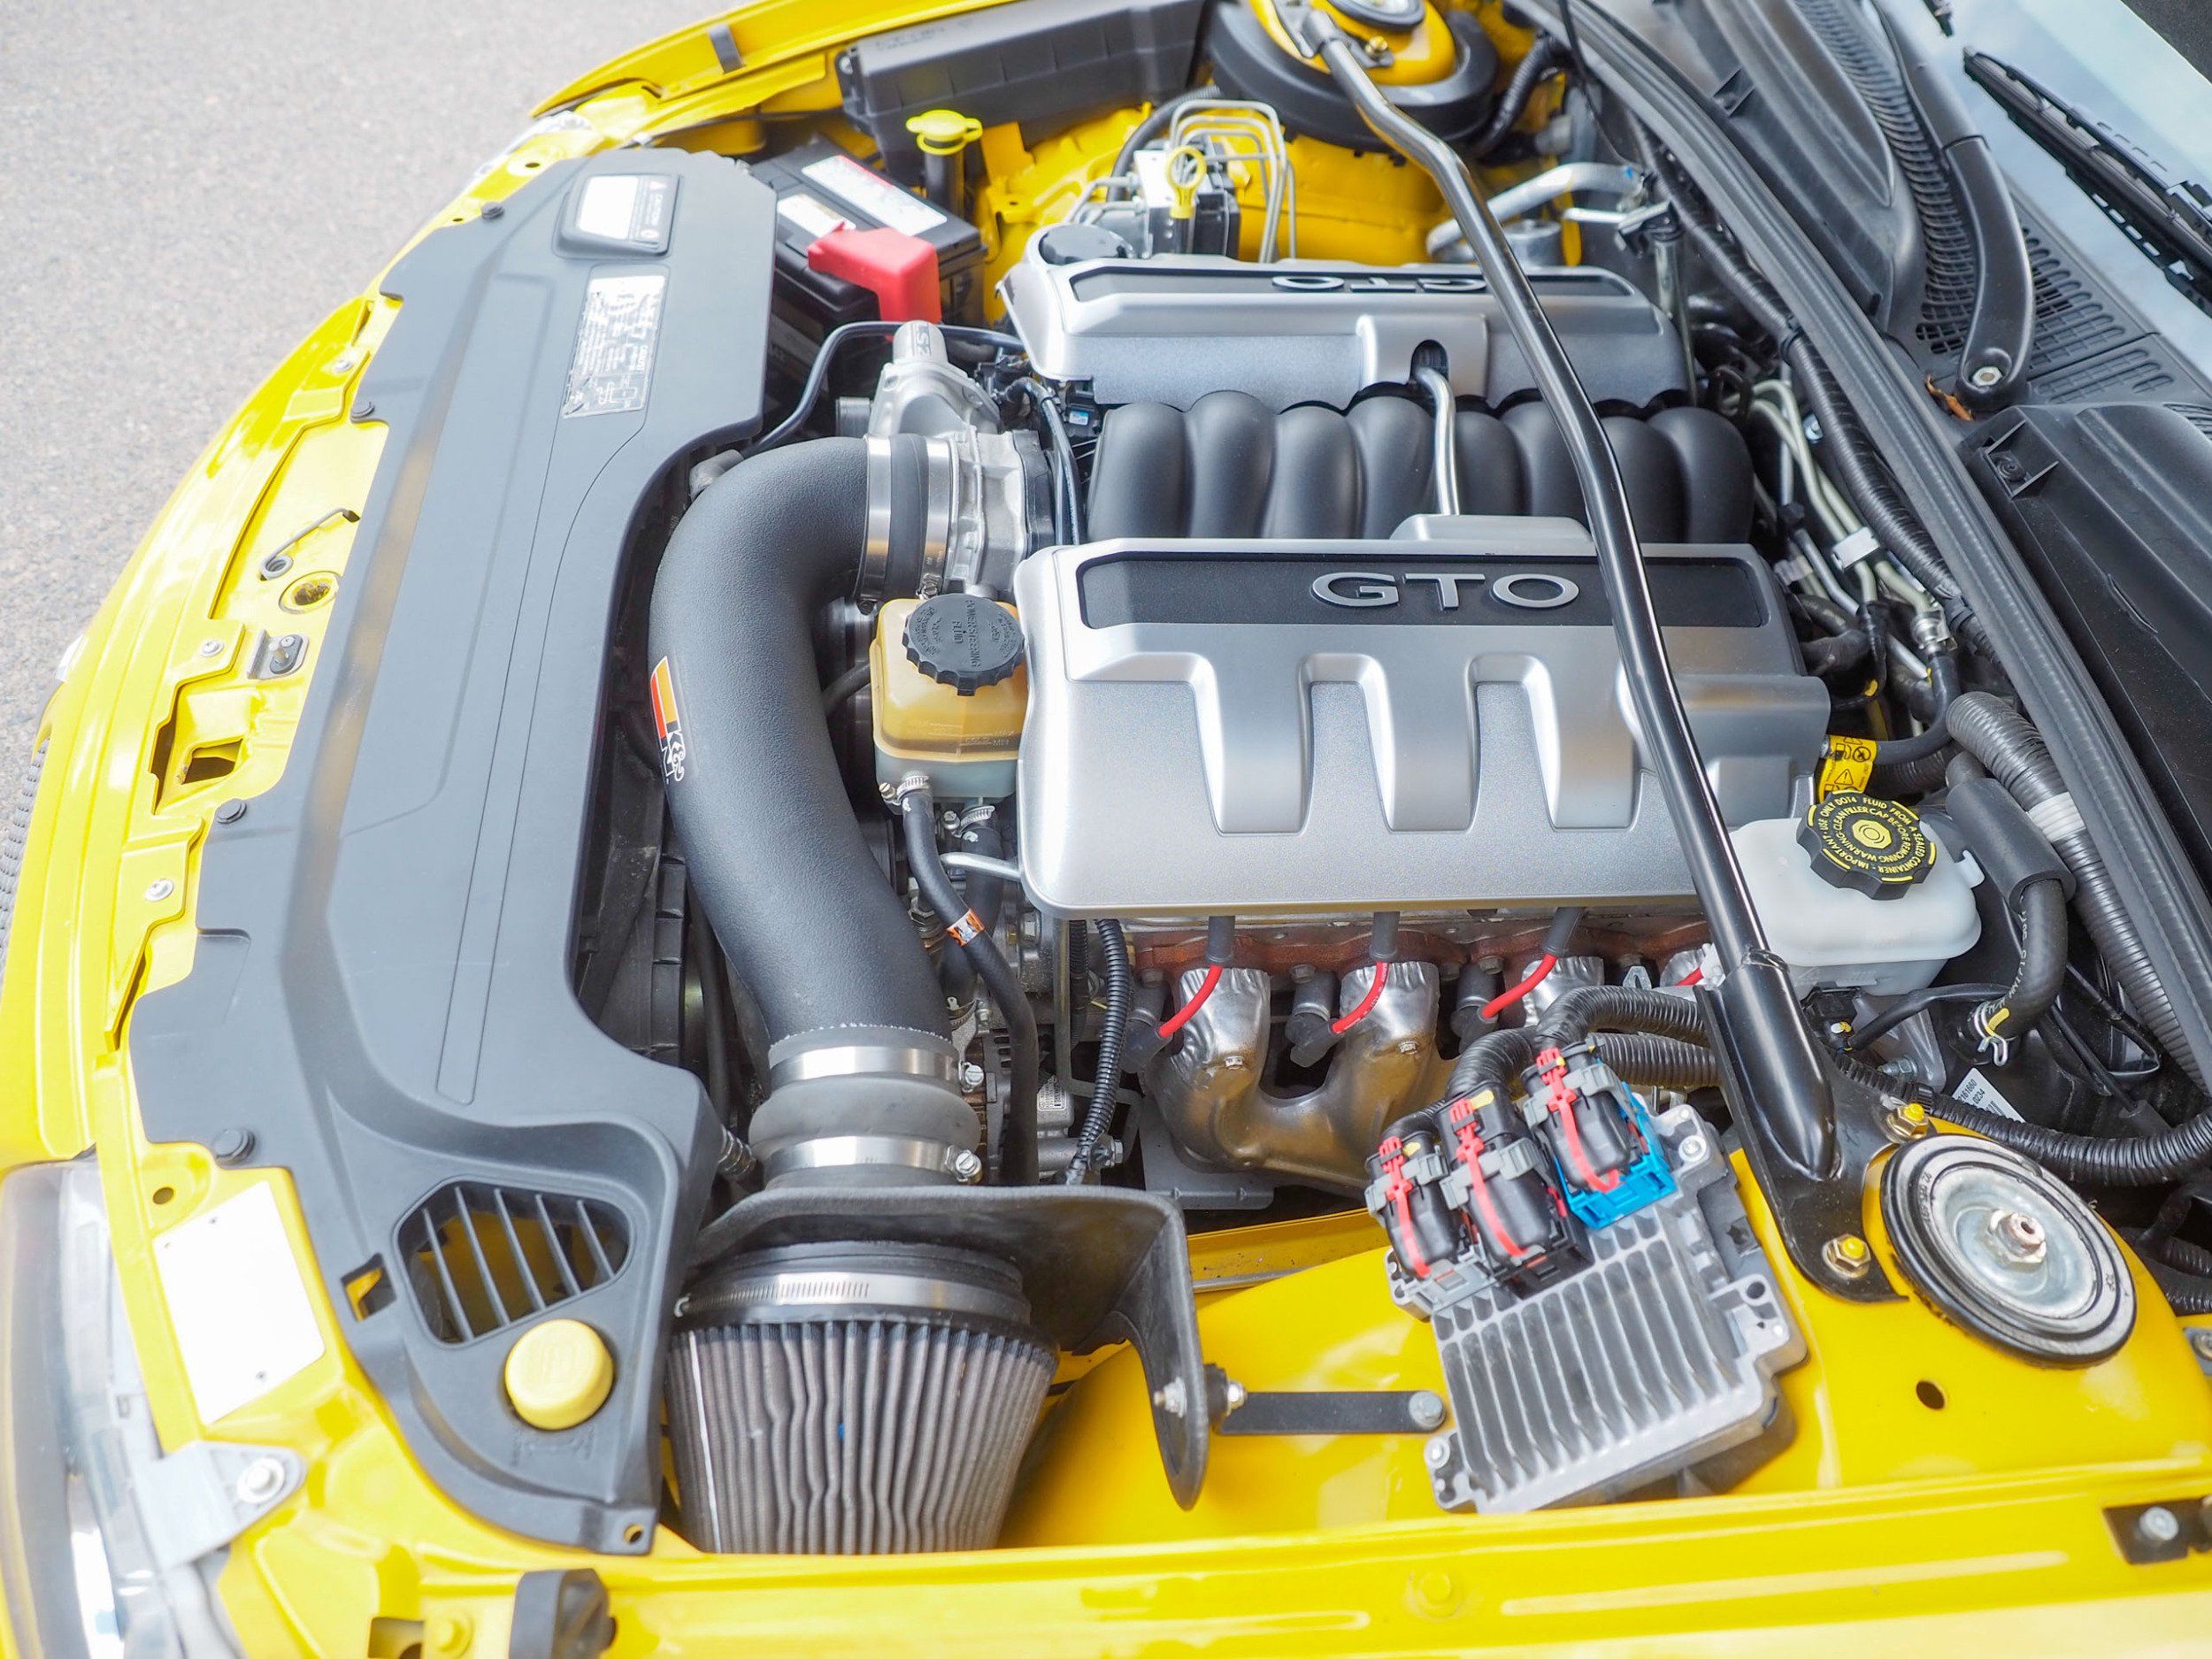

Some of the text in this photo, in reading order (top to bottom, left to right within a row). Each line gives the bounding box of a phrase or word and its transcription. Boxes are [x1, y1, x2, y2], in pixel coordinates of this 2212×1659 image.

[1272, 276, 1487, 293] GTO
[1310, 571, 1579, 609] GTO
[1820, 802, 1837, 818] ONLY
[1863, 797, 1888, 810] FLUID
[1869, 808, 1889, 819] CAP
[1889, 808, 1912, 825] FROM
[1817, 818, 1829, 830] USE
[1823, 834, 1870, 870] IMPORTANT
[1913, 833, 1926, 857] SEALED
[1878, 856, 1921, 874] CONTAINER
